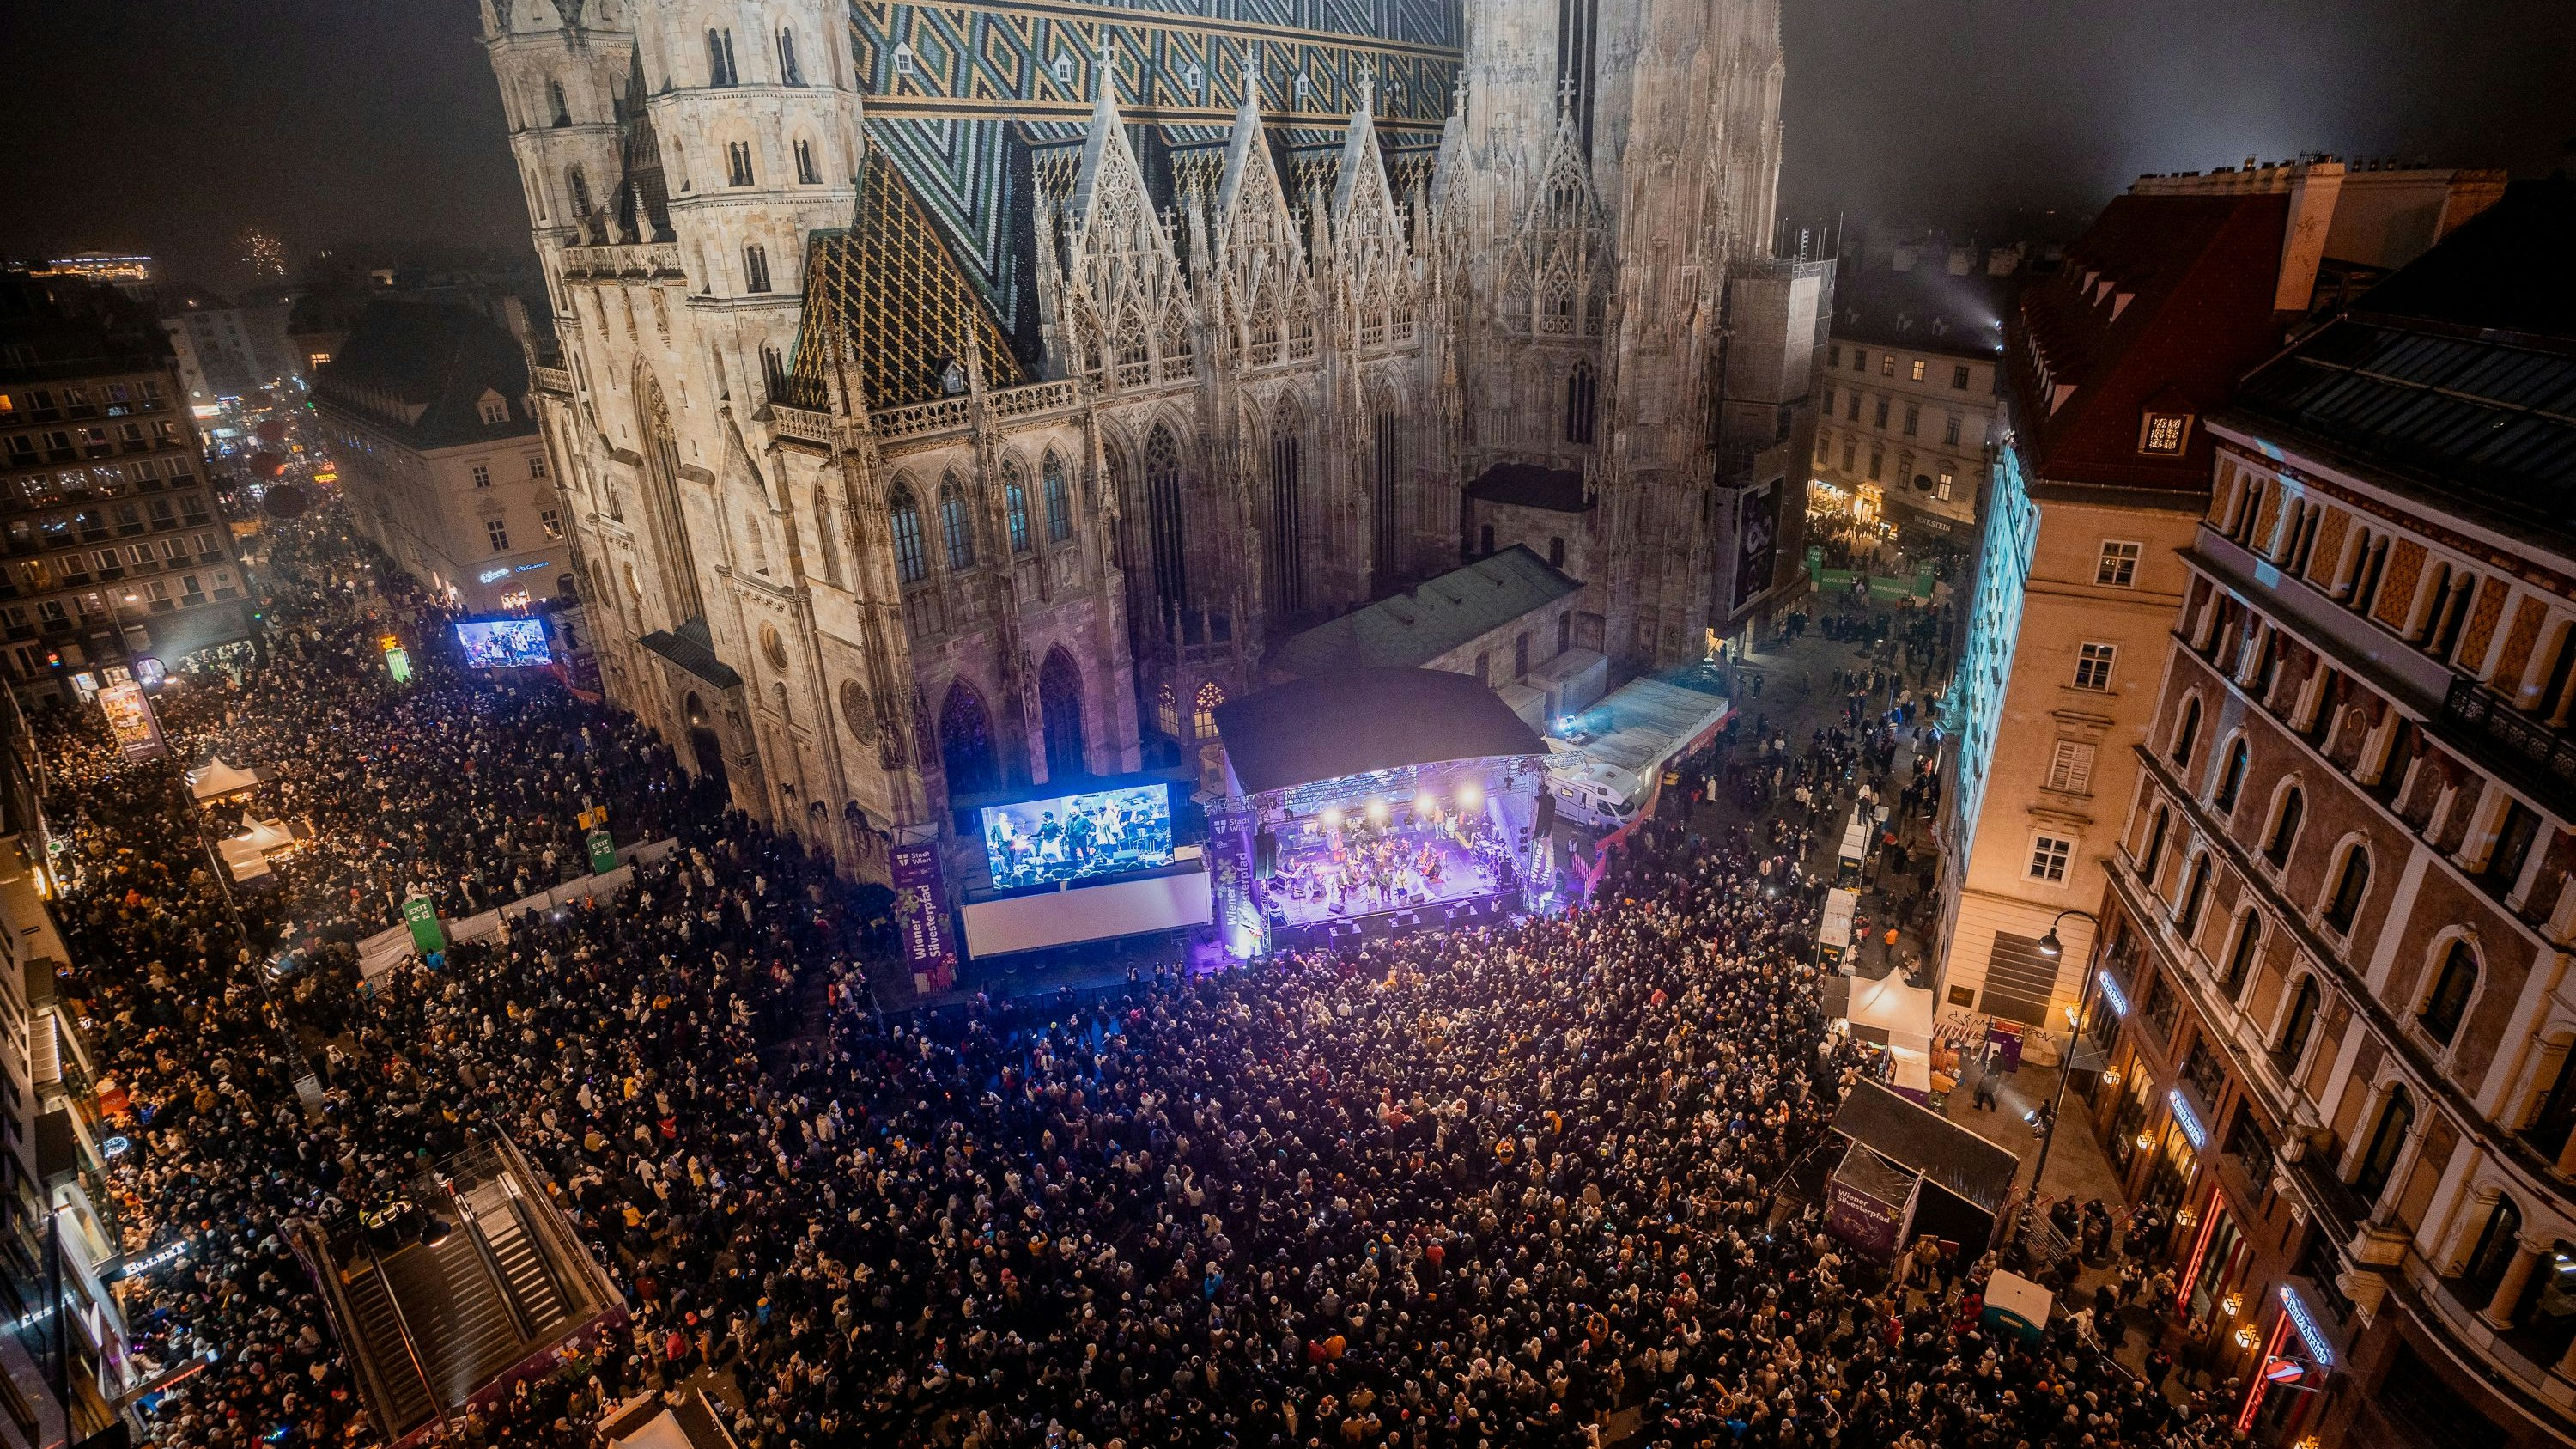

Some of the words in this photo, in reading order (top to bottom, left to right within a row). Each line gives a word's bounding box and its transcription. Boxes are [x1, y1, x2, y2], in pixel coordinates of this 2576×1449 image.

[1914, 515, 1951, 532] DENKSTEIN
[1229, 817, 1250, 825] Stadt
[1230, 825, 1251, 833] Wien
[592, 839, 608, 849] EXIT
[1531, 842, 1544, 883] Wiener
[408, 903, 428, 916] EXIT
[1226, 886, 1238, 926] Wiener
[916, 884, 941, 958] Silvesterpfad
[911, 918, 927, 960] Wiener
[1837, 1195, 1890, 1224] Silvesterpfad
[1838, 1188, 1868, 1207] Wiener
[2287, 1297, 2306, 1328] Bank
[2301, 1324, 2327, 1364] Austria
